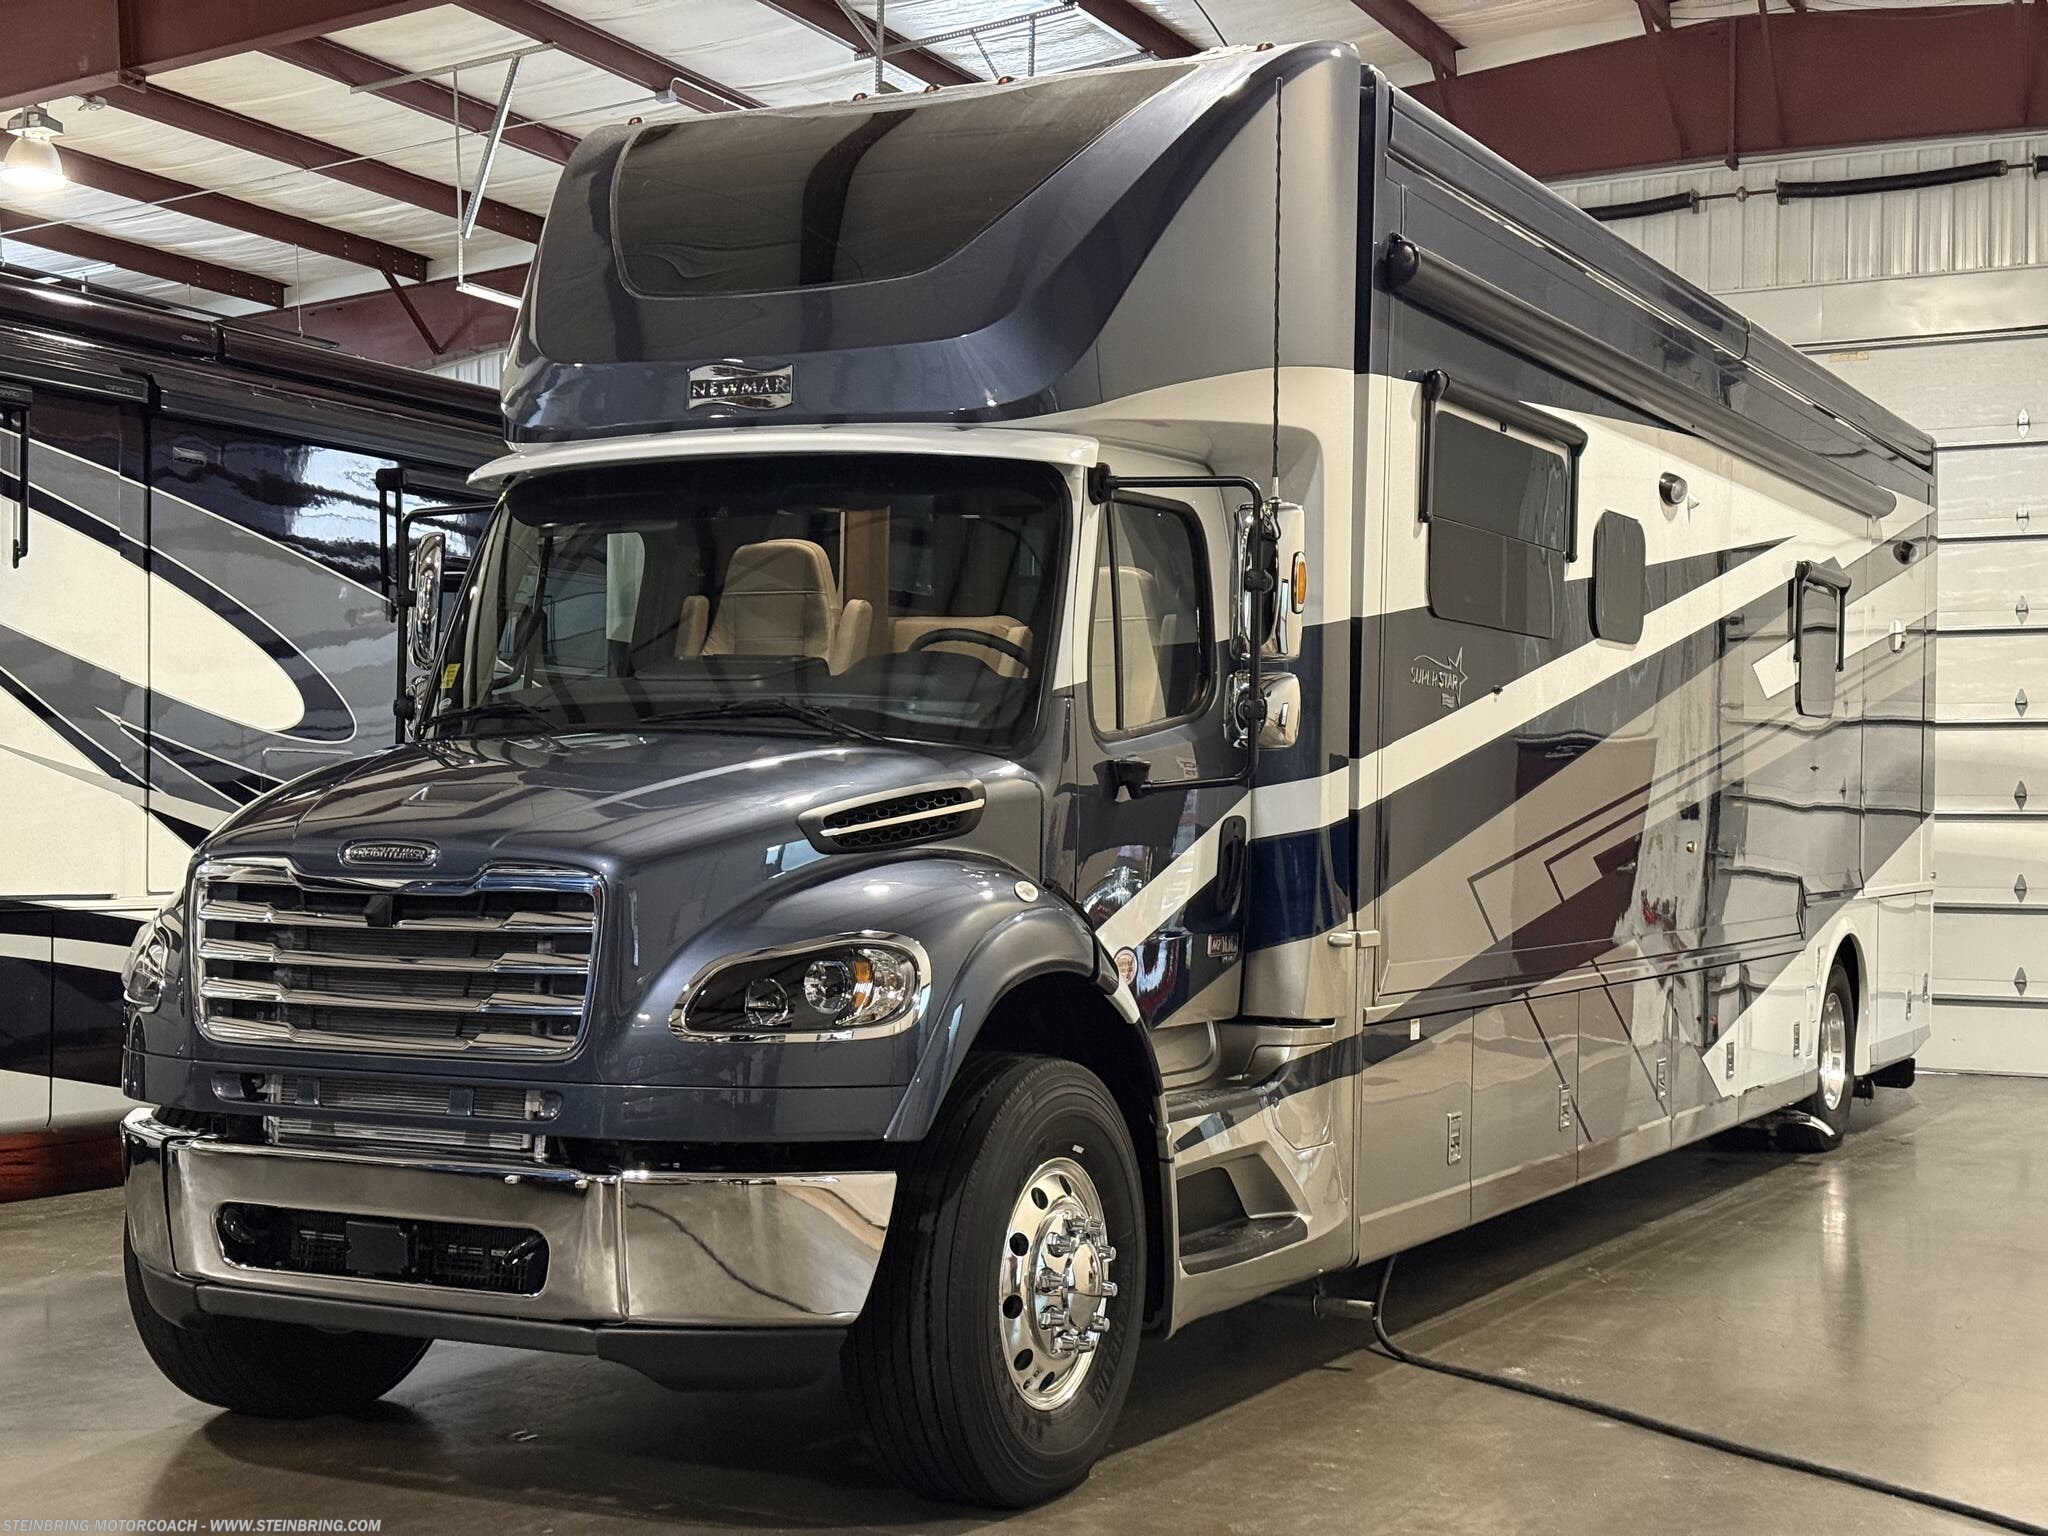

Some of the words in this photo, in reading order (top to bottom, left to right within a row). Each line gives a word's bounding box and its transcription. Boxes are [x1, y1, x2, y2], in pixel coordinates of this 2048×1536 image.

[692, 377, 790, 397] NEWMAR
[1410, 667, 1438, 687] SUPER
[1439, 671, 1458, 690] STAR
